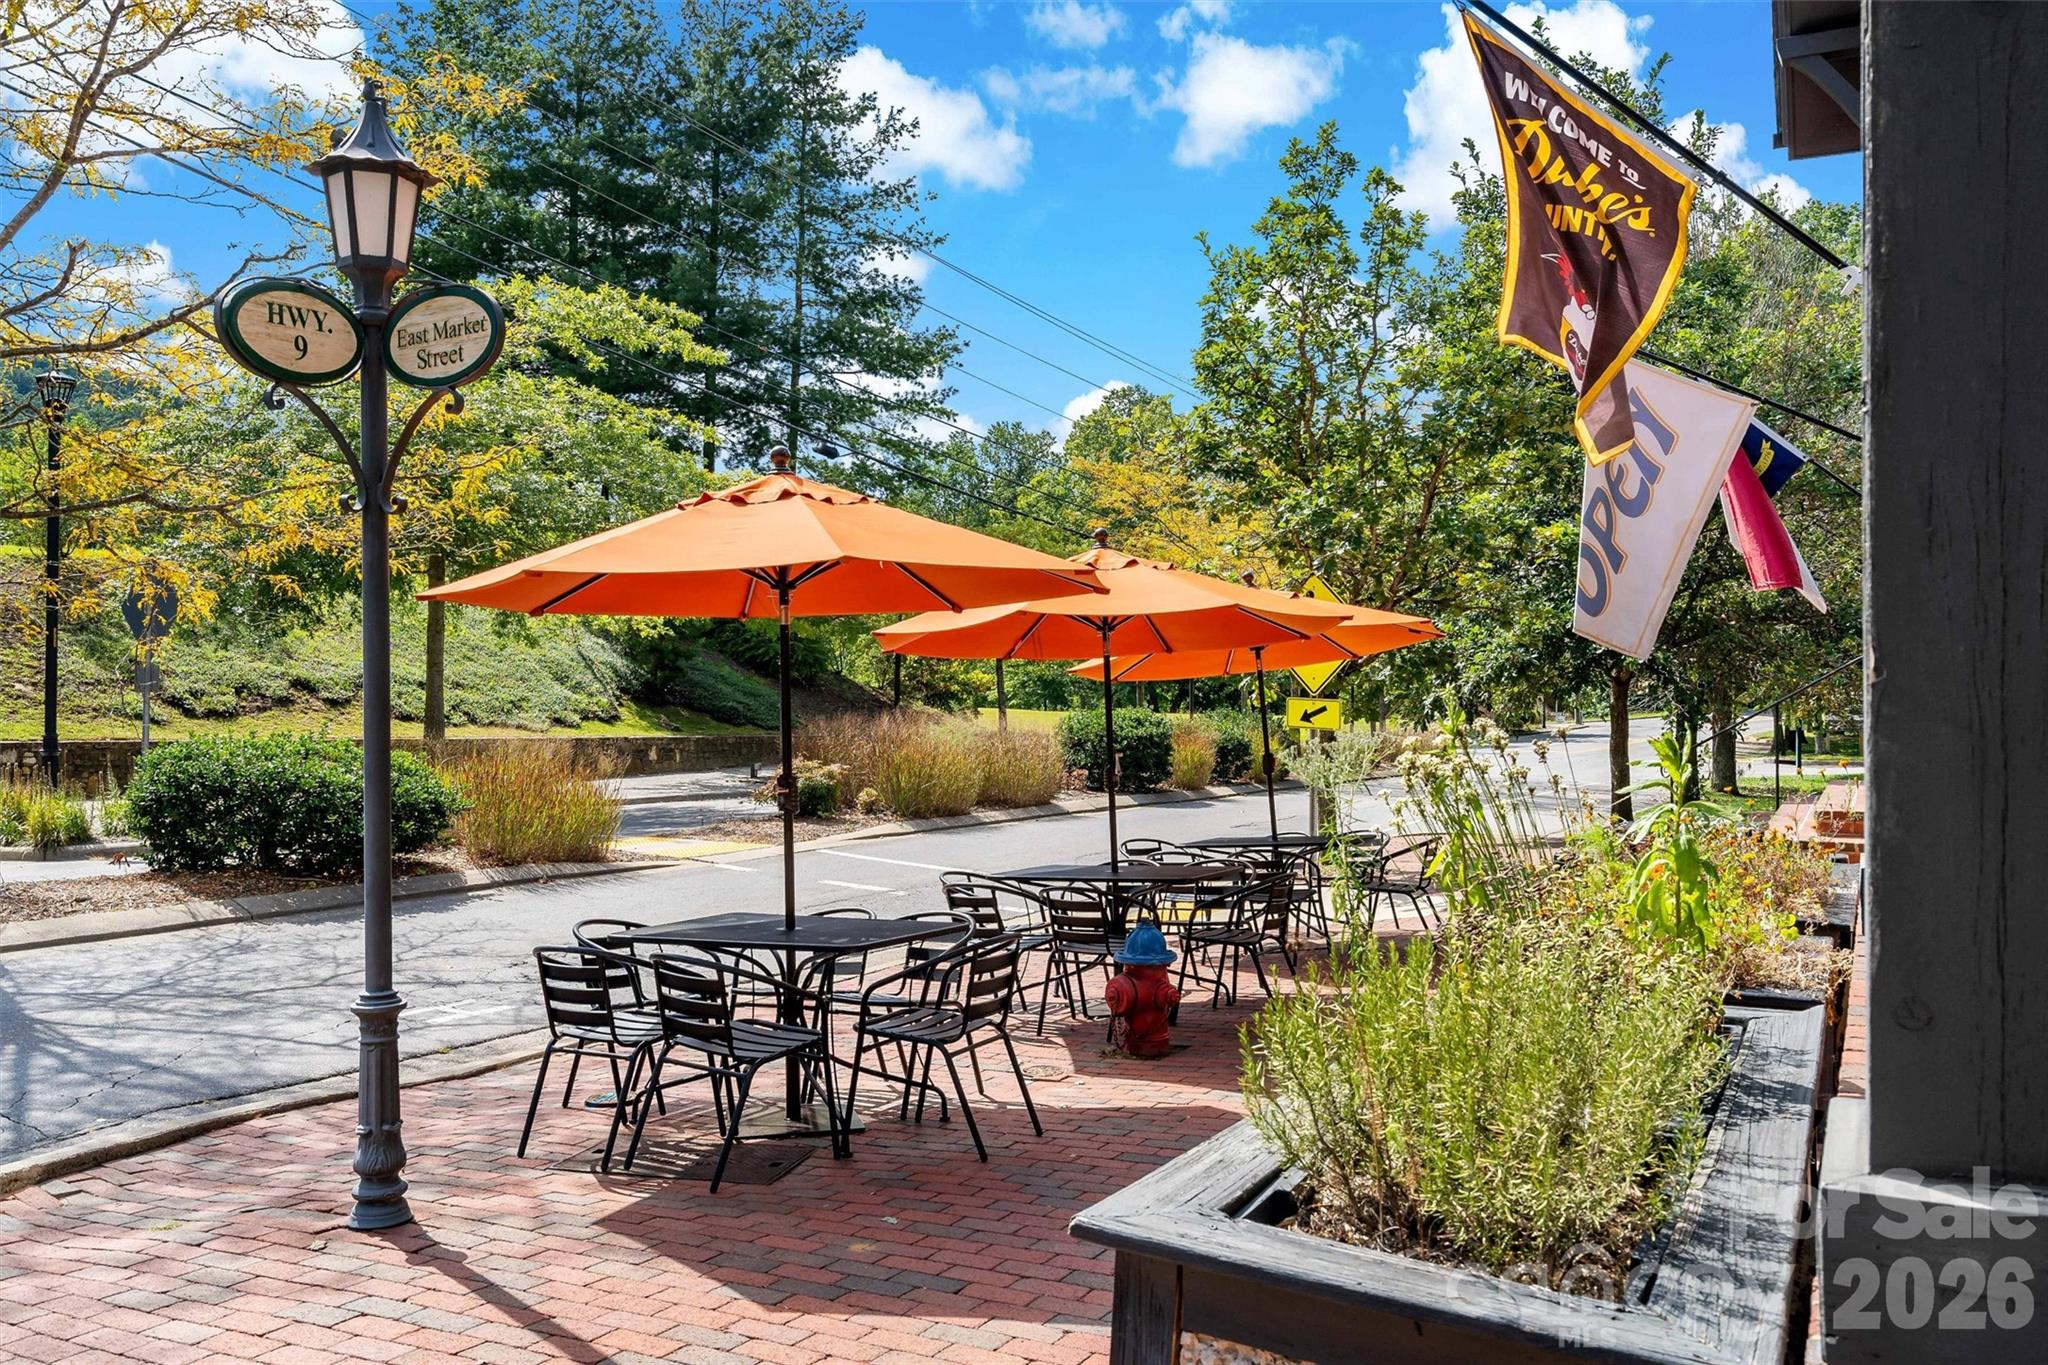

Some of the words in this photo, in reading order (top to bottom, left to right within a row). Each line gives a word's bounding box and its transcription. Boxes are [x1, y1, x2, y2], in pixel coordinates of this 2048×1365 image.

[1506, 117, 1656, 232] Duke's
[1617, 158, 1640, 182] TO
[266, 301, 333, 334] HWY.
[397, 328, 429, 349] East
[432, 315, 488, 340] Market
[293, 334, 309, 361] 9
[416, 345, 464, 370] Street
